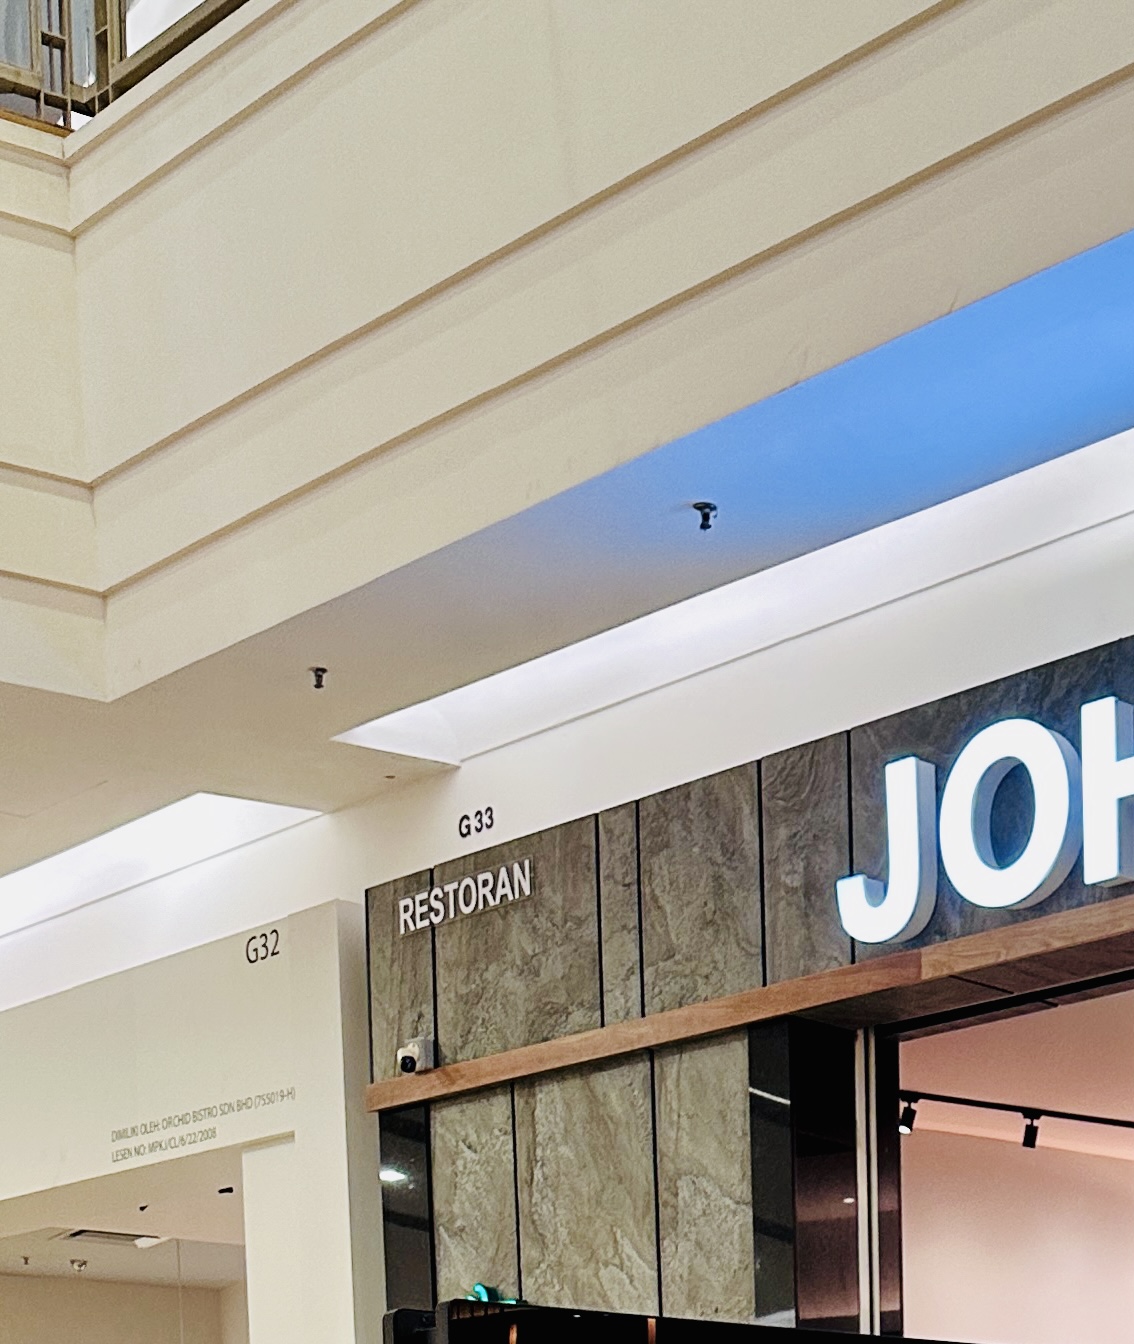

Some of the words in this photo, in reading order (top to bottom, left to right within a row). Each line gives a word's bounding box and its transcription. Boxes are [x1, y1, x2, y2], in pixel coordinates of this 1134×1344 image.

[399, 858, 532, 935] RESTORAN
[246, 929, 280, 963] G32
[162, 1112, 191, 1131] ORCHID
[192, 1106, 218, 1123] BISTRO
[219, 1101, 236, 1117] SDN
[236, 1097, 254, 1113] BHD
[111, 1146, 134, 1163] LESEN
